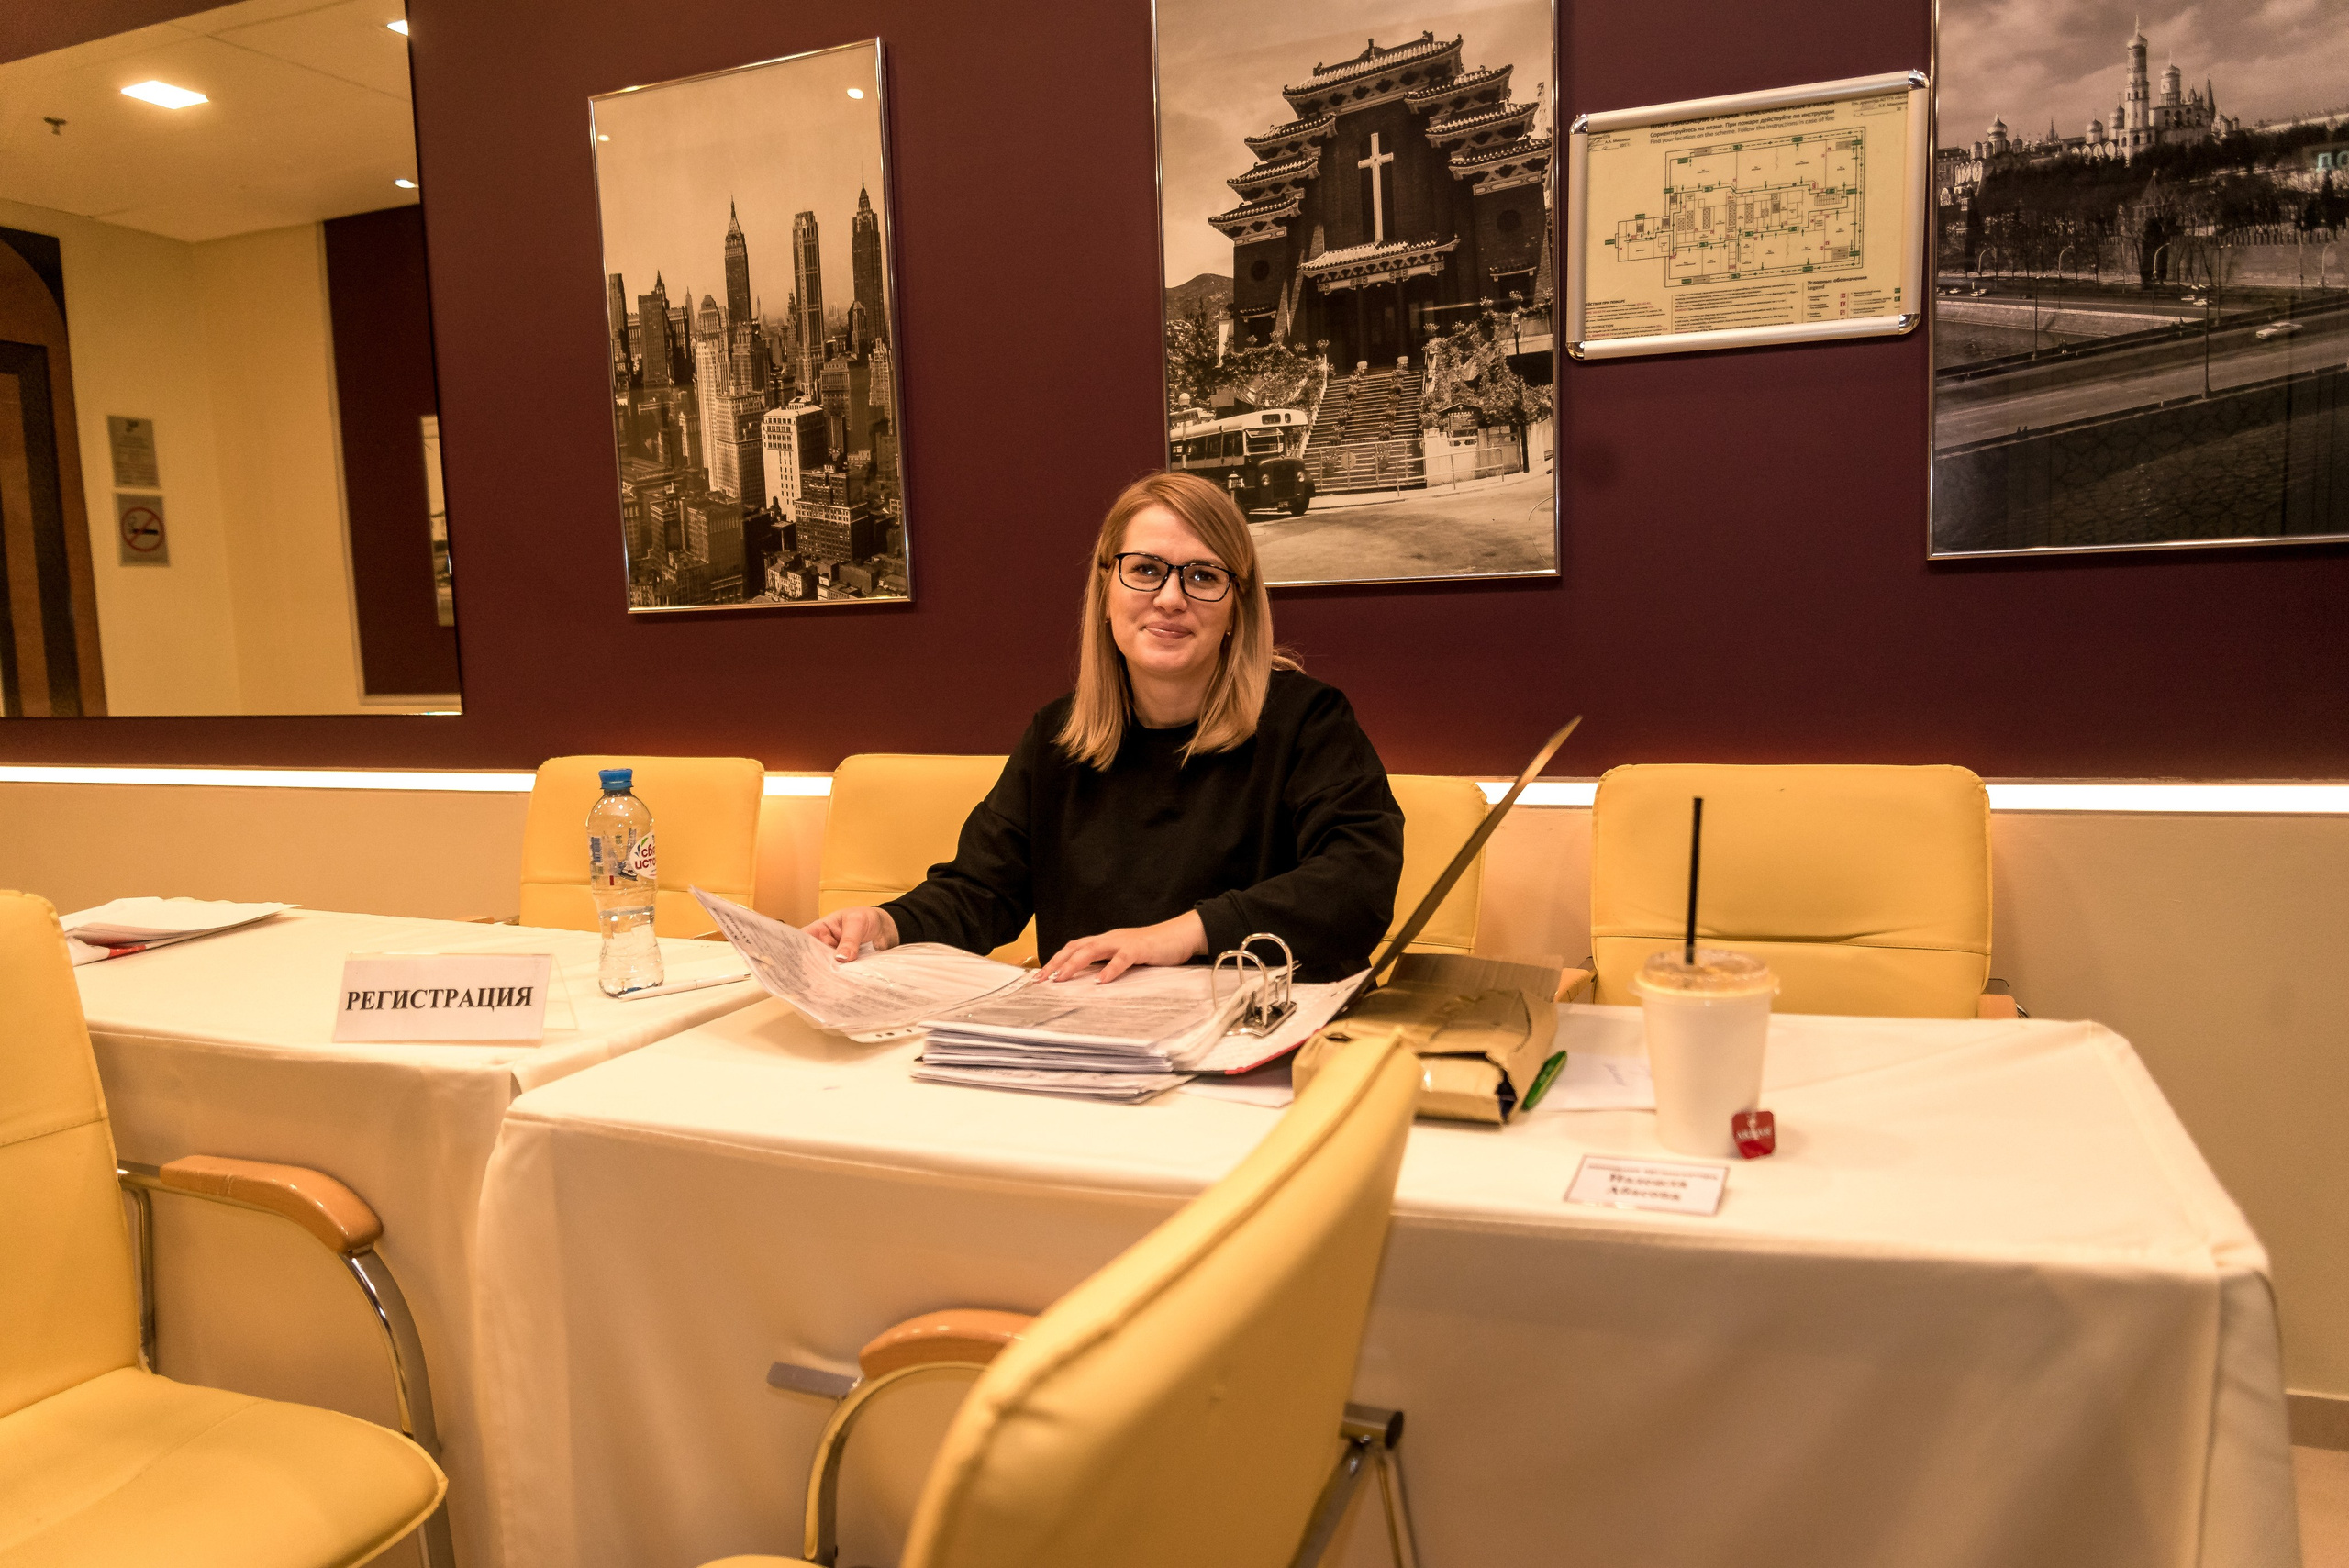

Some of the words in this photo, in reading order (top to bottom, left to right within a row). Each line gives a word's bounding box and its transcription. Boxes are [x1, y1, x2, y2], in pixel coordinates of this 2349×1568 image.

[1650, 128, 1697, 138] Сориентируйтесь
[1760, 115, 1791, 124] действуйте
[1801, 109, 1835, 117] инструкции
[1766, 121, 1798, 129] instructions
[345, 986, 534, 1012] РЕГИСТРАЦИЯ
